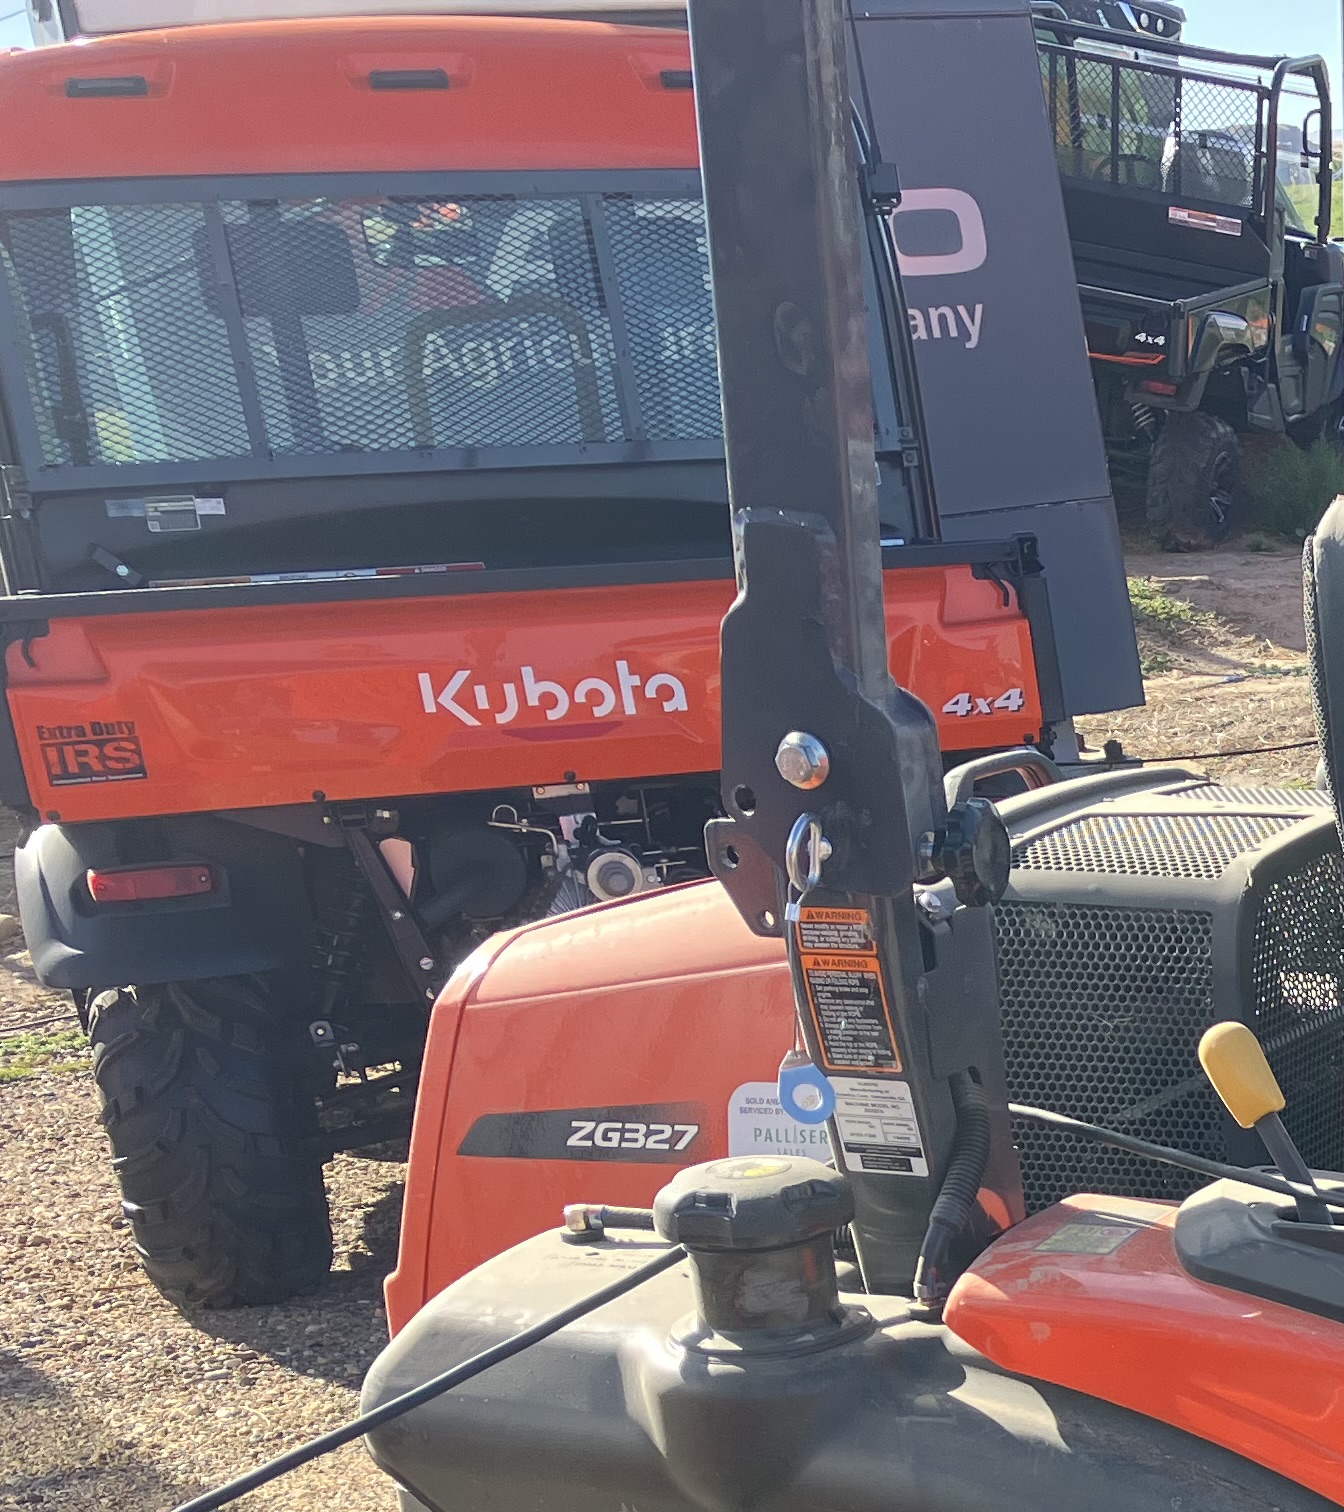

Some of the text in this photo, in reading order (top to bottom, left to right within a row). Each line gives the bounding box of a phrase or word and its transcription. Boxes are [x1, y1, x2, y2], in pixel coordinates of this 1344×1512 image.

[1134, 332, 1166, 346] 4x4
[417, 660, 688, 726] Kubota
[942, 688, 1024, 717] 4x4
[36, 721, 136, 741] Extra Duty
[45, 741, 141, 775] IRS
[815, 910, 862, 921] WARNING
[821, 957, 868, 969] WARNING
[566, 1121, 699, 1150] ZG327
[776, 1148, 807, 1158] SALES
